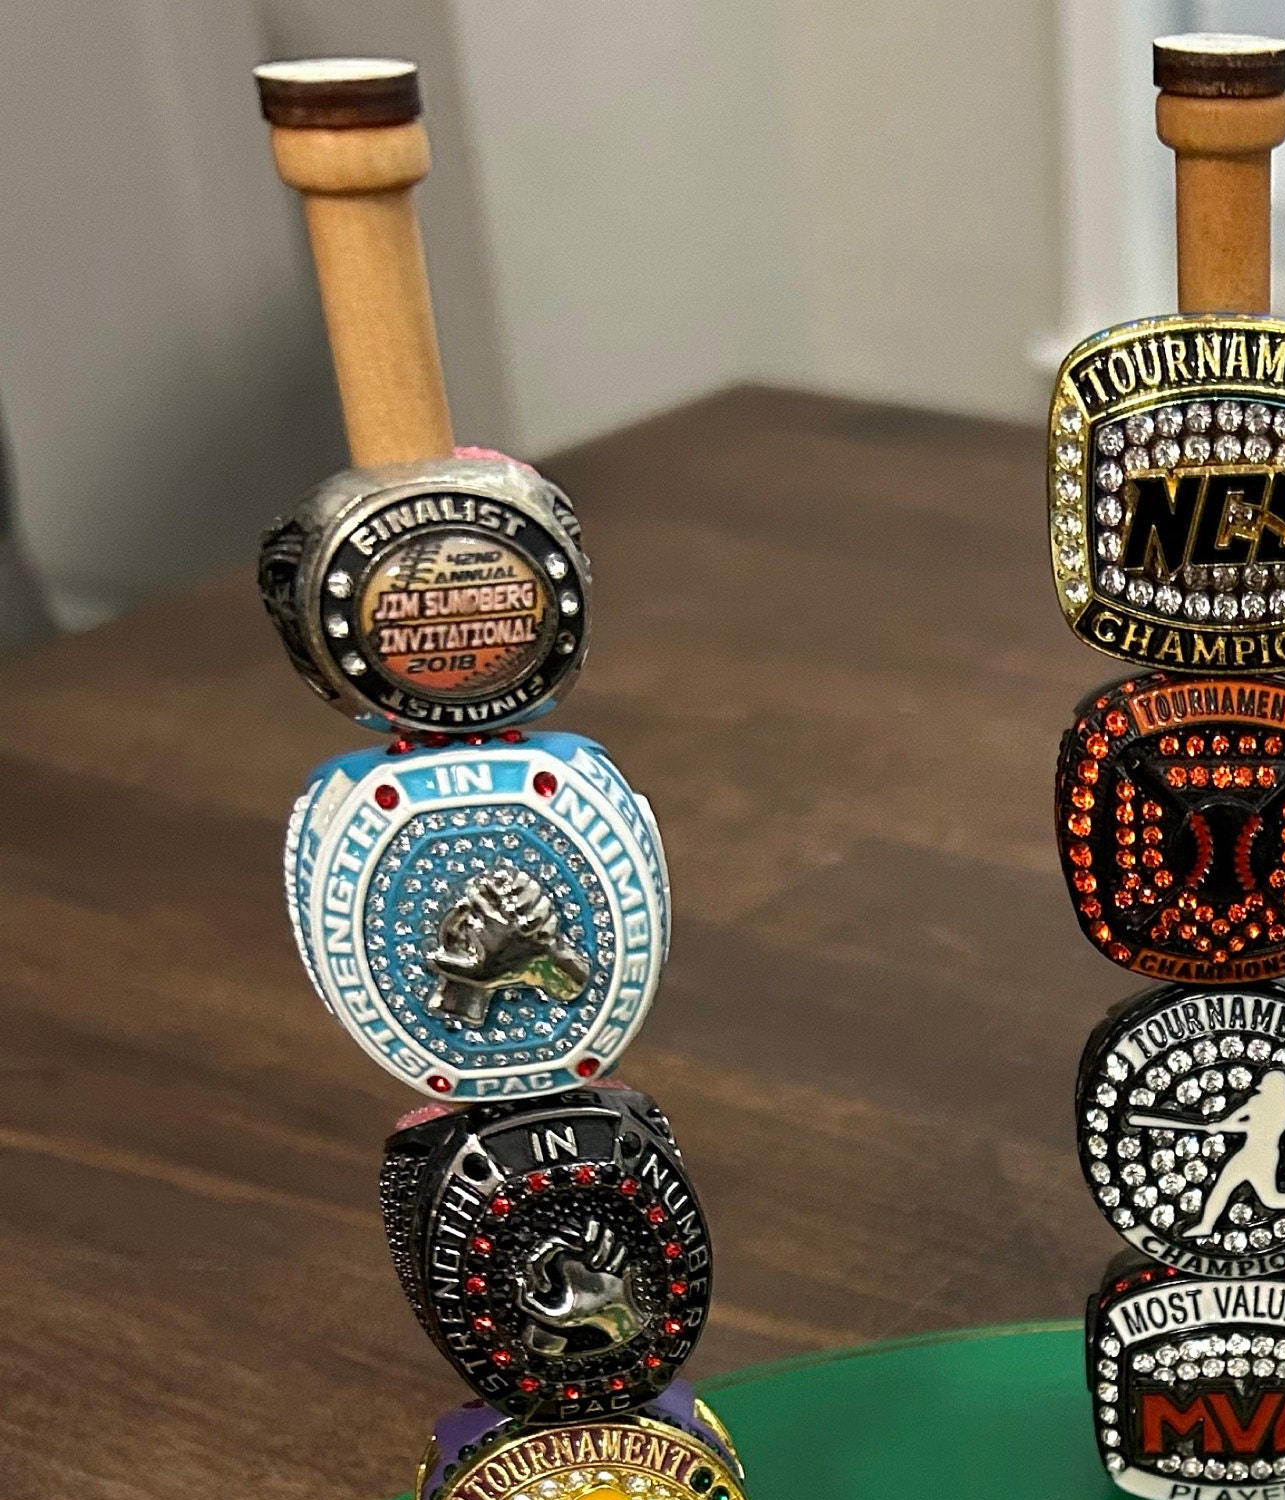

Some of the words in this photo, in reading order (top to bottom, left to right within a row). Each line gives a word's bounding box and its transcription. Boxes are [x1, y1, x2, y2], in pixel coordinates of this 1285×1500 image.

[350, 496, 528, 556] FINALIST
[428, 565, 519, 586] ANNUAL
[374, 590, 422, 621] JIM
[424, 580, 537, 616] SUNDBERG
[378, 616, 538, 656] INVITATIONAL
[406, 654, 478, 675] 2018
[322, 805, 432, 1078] STRENGTH
[434, 763, 492, 796] IN
[556, 787, 653, 1056] NUMBERS
[476, 1071, 555, 1097] PAC
[431, 1182, 509, 1393] STRENGTH
[530, 1125, 579, 1163] IN
[642, 1153, 709, 1359] NUMBERS
[1121, 1289, 1203, 1337] MOST
[558, 1393, 632, 1421] PAC
